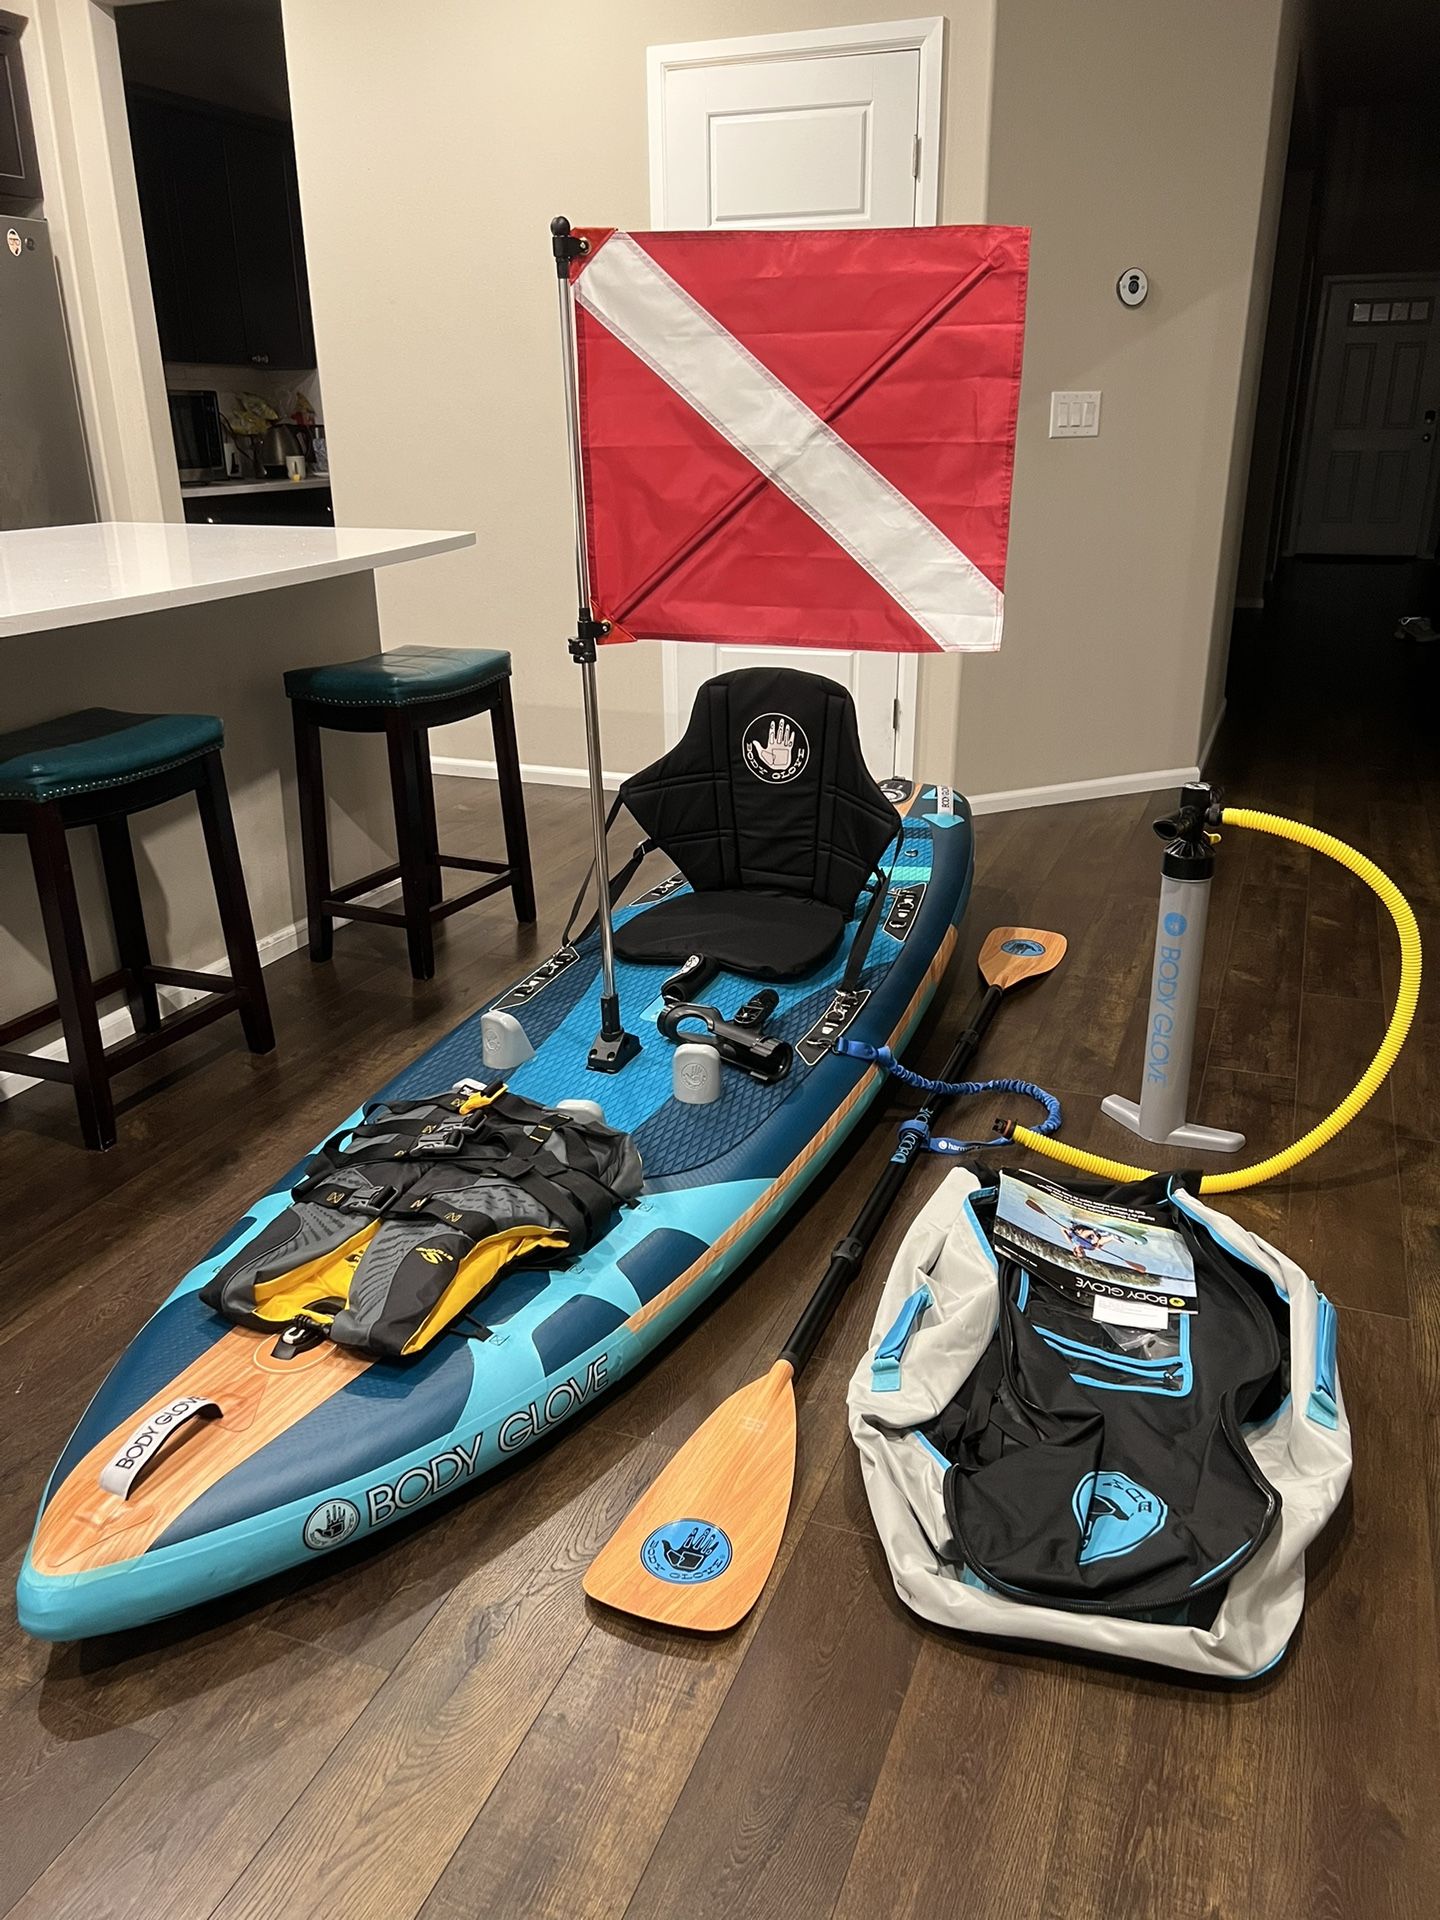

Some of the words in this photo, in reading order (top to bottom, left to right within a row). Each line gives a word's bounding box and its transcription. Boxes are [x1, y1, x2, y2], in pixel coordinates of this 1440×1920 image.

[1156, 946, 1182, 1011] BODY
[1147, 1013, 1174, 1088] GLOVE
[1075, 1277, 1125, 1297] GLOVE
[1127, 1290, 1168, 1305] BODY
[115, 1426, 158, 1470] BODY
[367, 1432, 484, 1528] BODY
[498, 1353, 609, 1452] GLOVE
